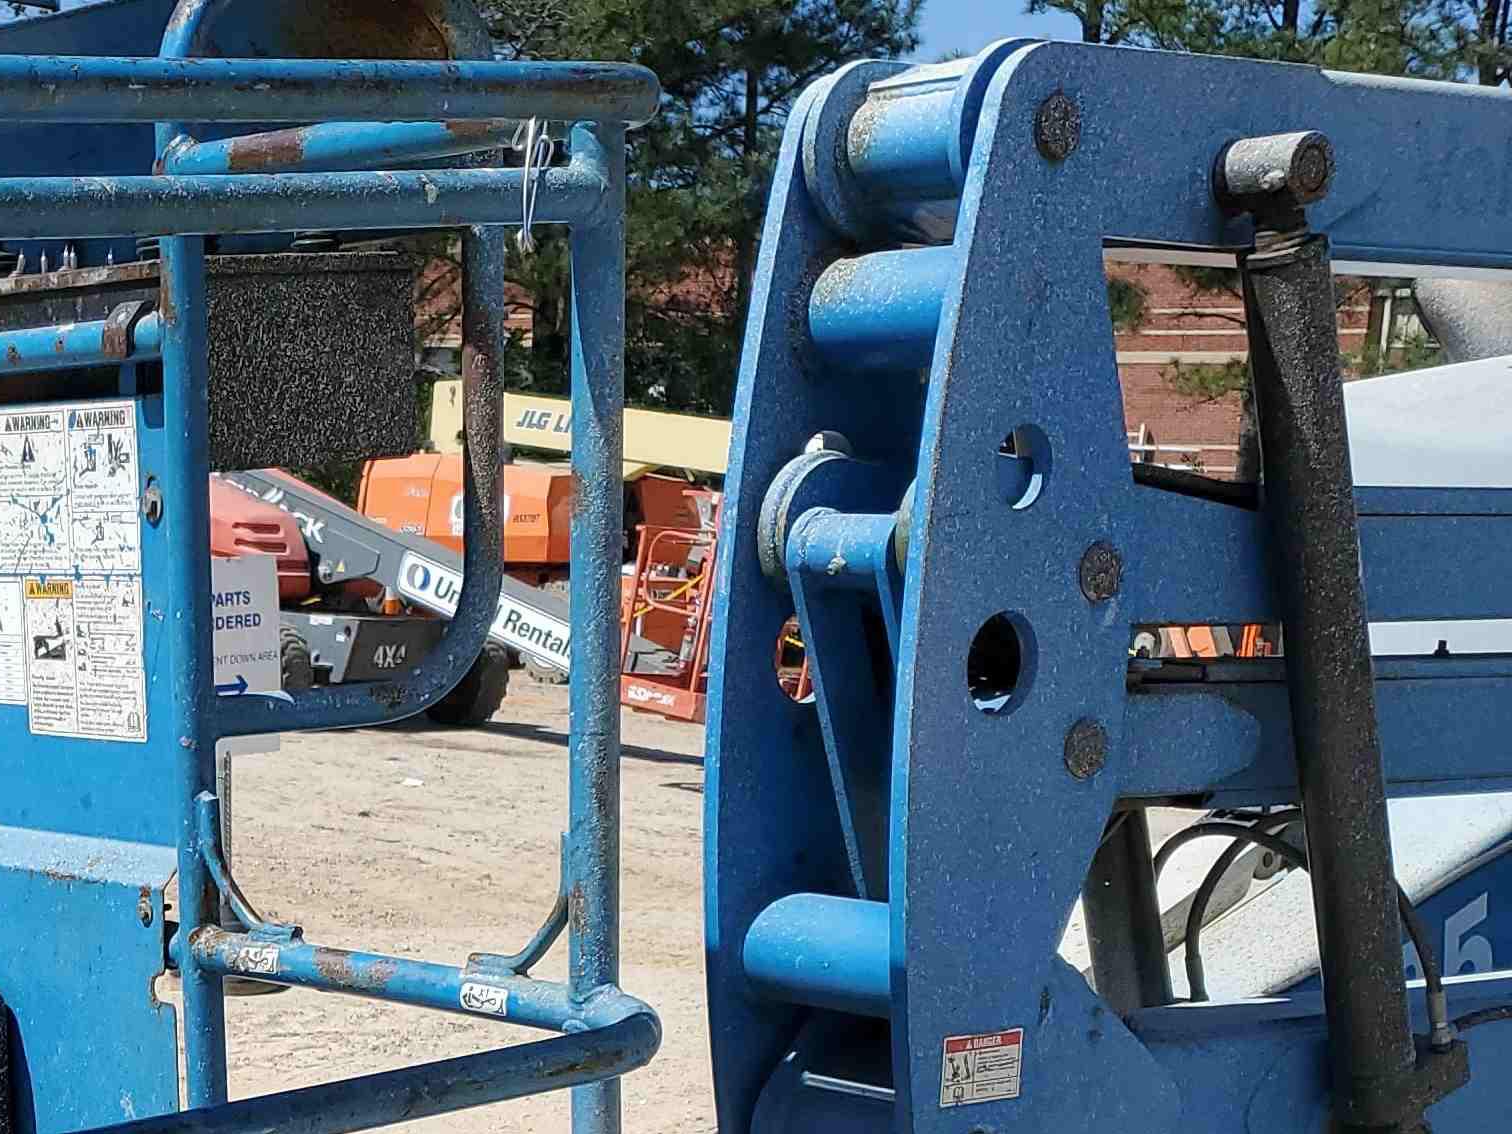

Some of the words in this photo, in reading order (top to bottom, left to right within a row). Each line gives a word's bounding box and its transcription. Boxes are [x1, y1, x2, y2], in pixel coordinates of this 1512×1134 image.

[13, 414, 51, 432] WARNING
[83, 409, 126, 427] WARNING
[515, 409, 552, 430] JLG
[214, 613, 262, 631] DERED
